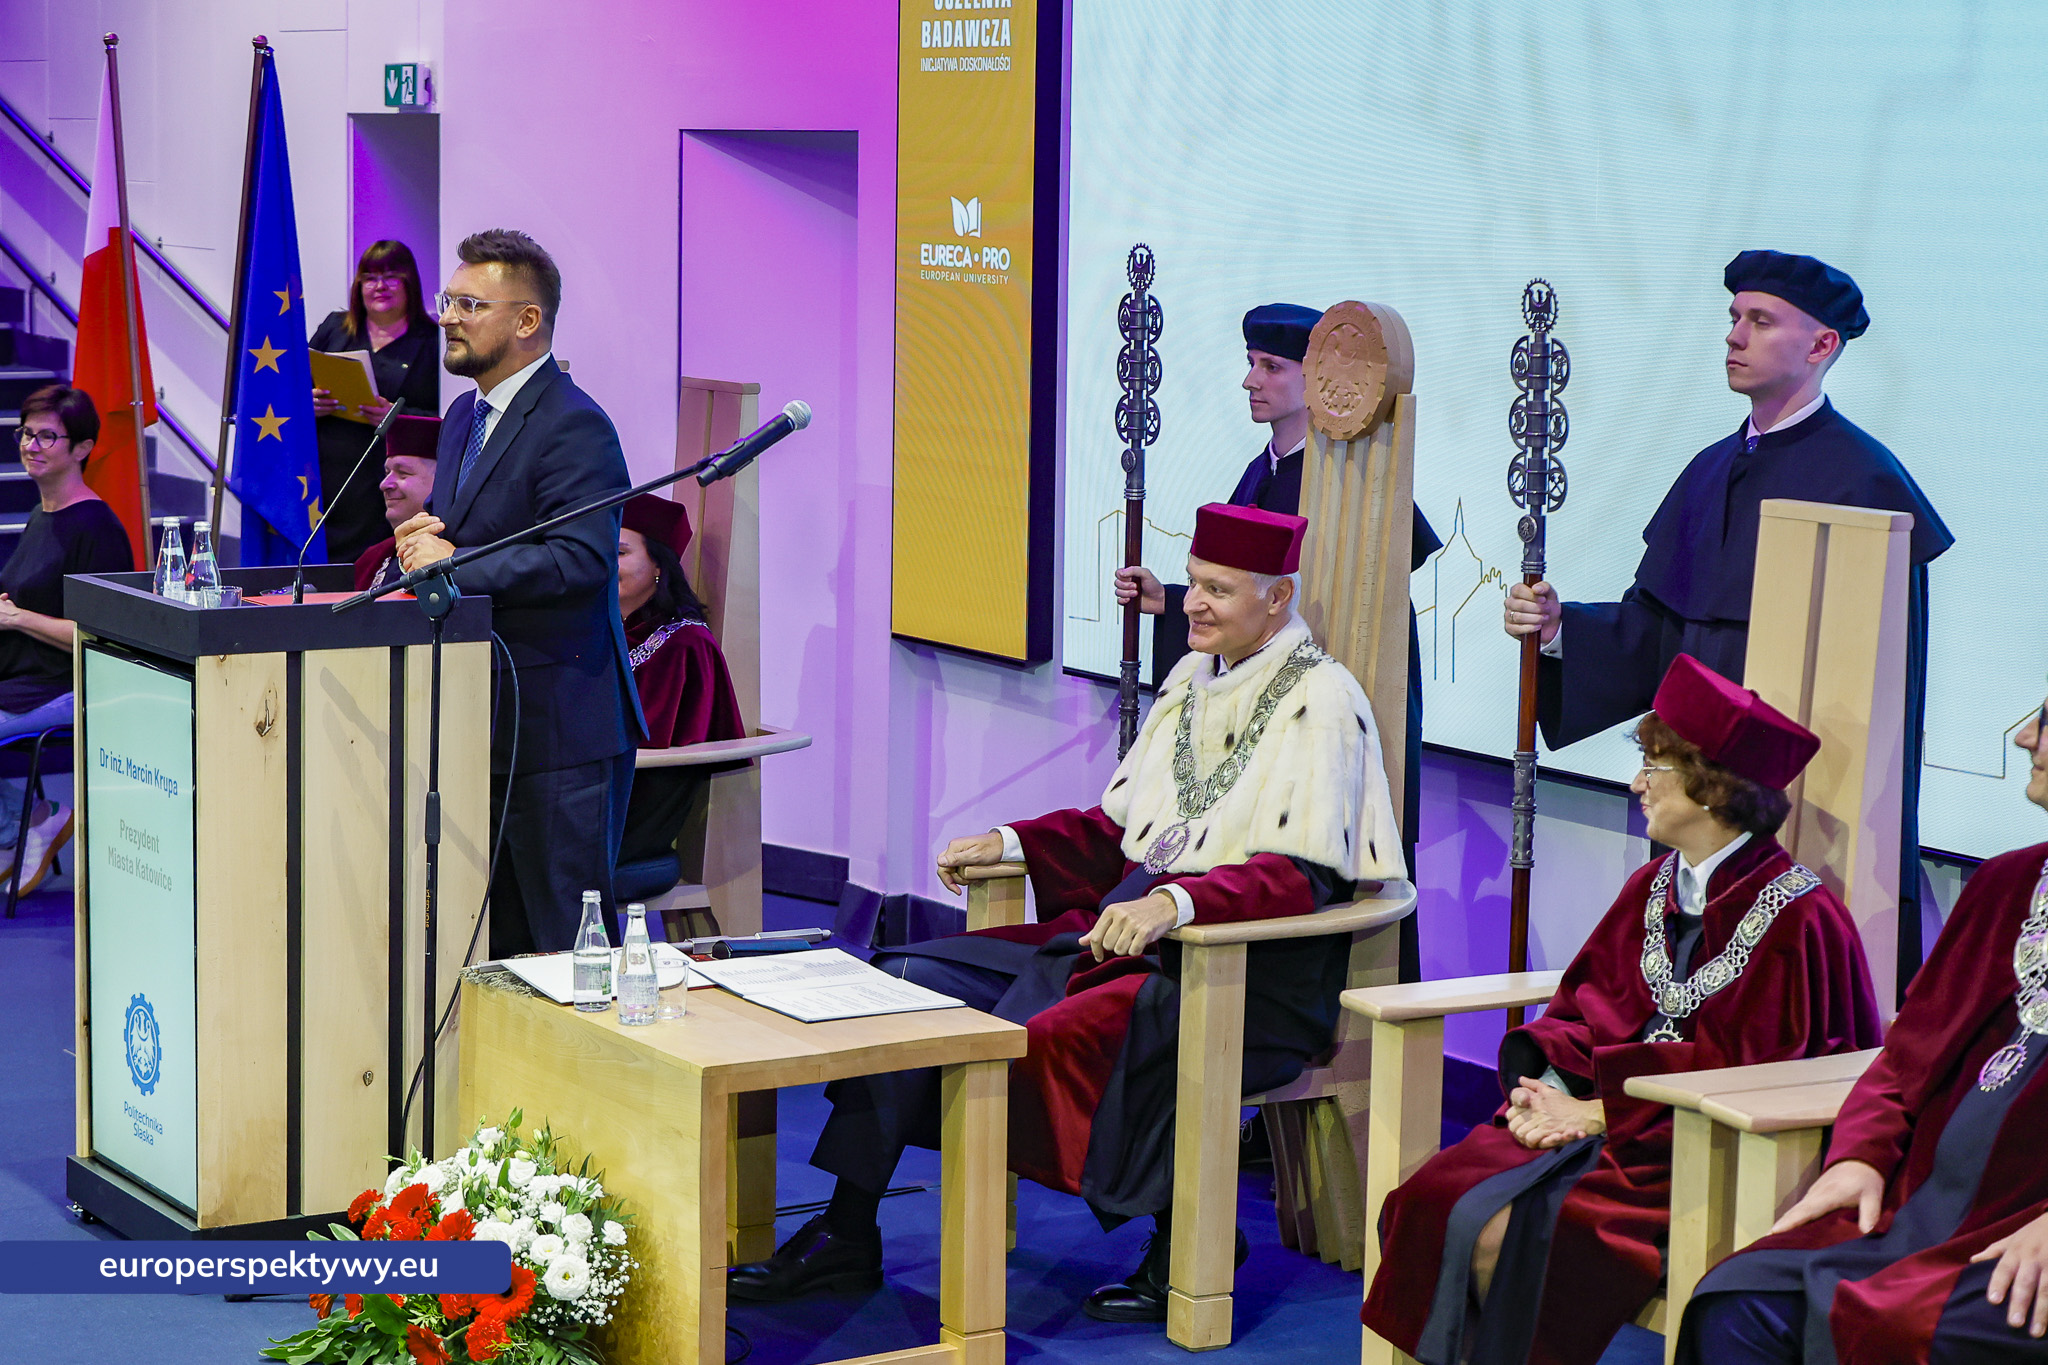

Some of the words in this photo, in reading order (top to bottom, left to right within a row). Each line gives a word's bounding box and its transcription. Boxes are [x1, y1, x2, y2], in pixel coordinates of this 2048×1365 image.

[921, 18, 1012, 48] BADAWCZA
[920, 57, 959, 72] INICJATYWA
[959, 53, 1011, 71] DOSKONAŁOŚCI
[920, 269, 961, 282] EUROPEAN
[963, 272, 1009, 285] UNIVERSITY
[100, 747, 109, 769] Dr
[110, 750, 125, 775] inż.
[126, 756, 153, 786] Marcin
[154, 767, 178, 799] Krupa
[119, 818, 160, 855] Prezydent
[108, 845, 134, 875] Miasta
[135, 856, 173, 892] Katowice
[124, 1100, 163, 1135] Politechnika
